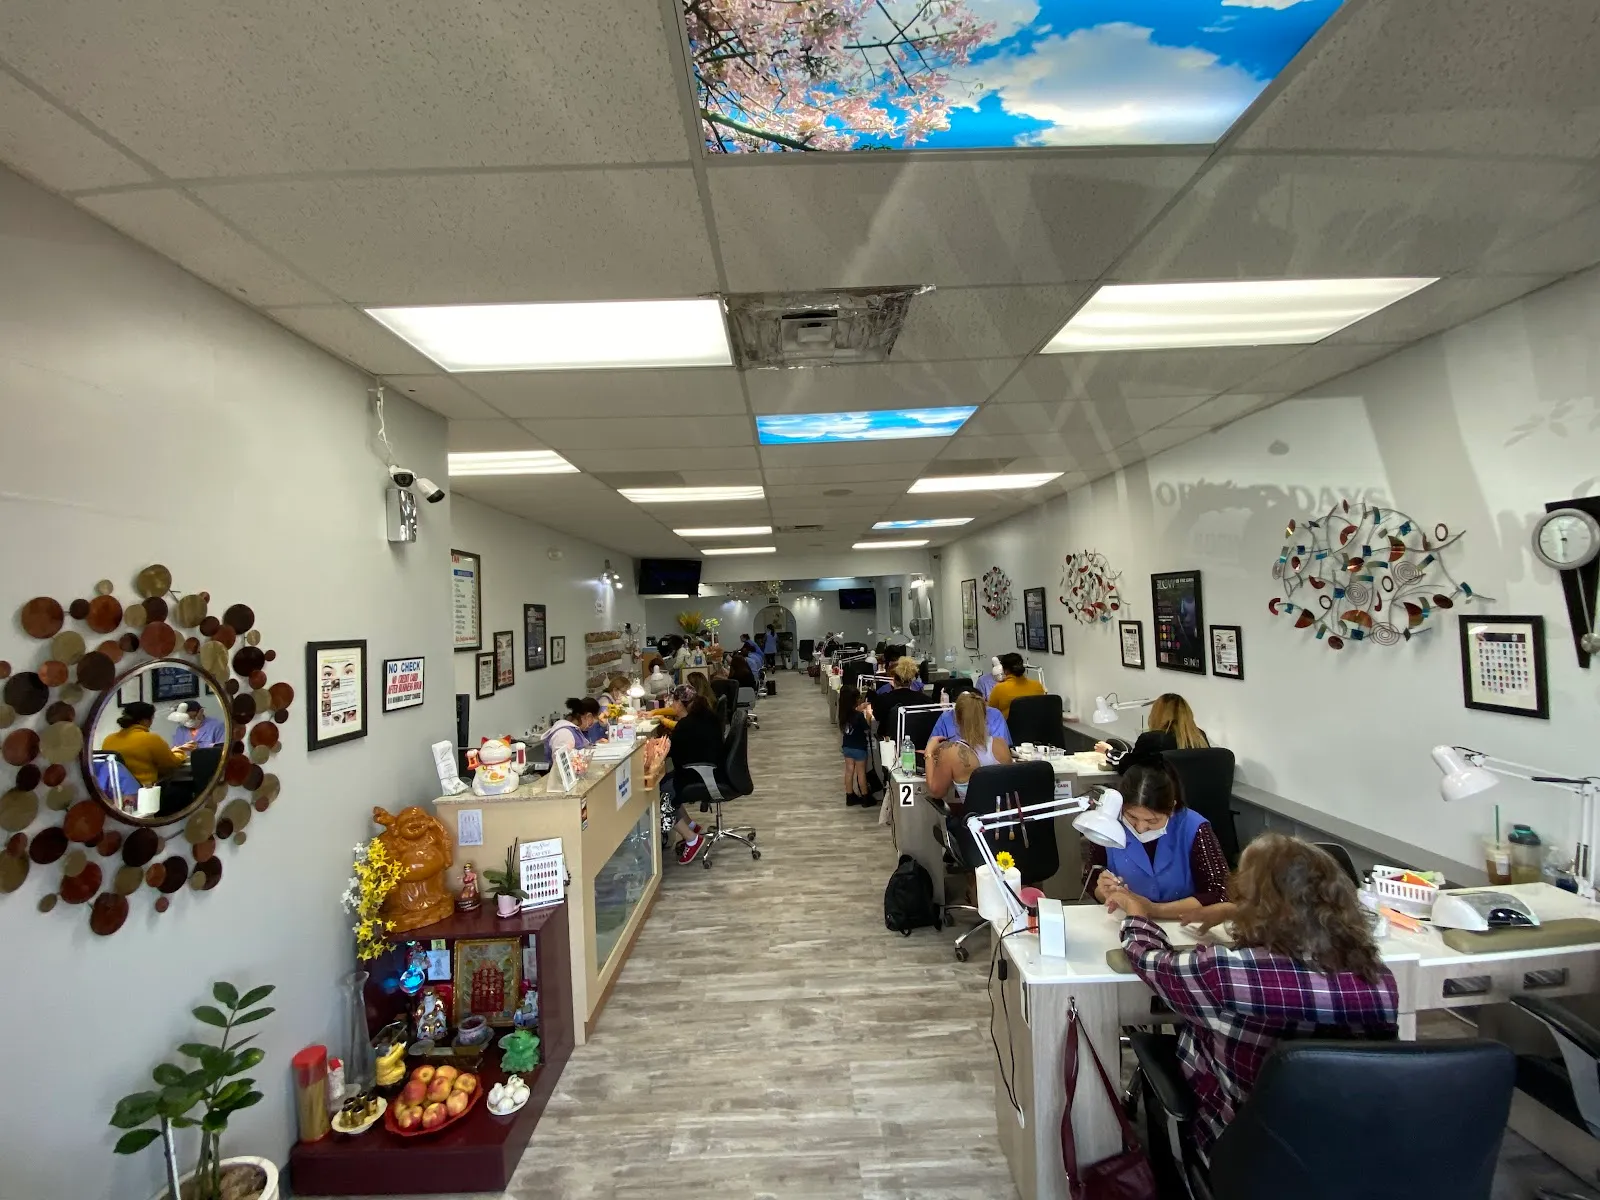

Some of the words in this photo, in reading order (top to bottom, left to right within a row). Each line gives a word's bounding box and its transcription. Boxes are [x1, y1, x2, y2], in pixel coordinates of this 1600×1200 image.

[389, 663, 397, 674] NO
[401, 661, 420, 672] CHECK
[398, 674, 410, 682] CREDIT
[410, 673, 418, 682] CARD
[388, 684, 398, 694] AFTER
[398, 682, 413, 693] BUSINESS
[902, 786, 911, 805] 2
